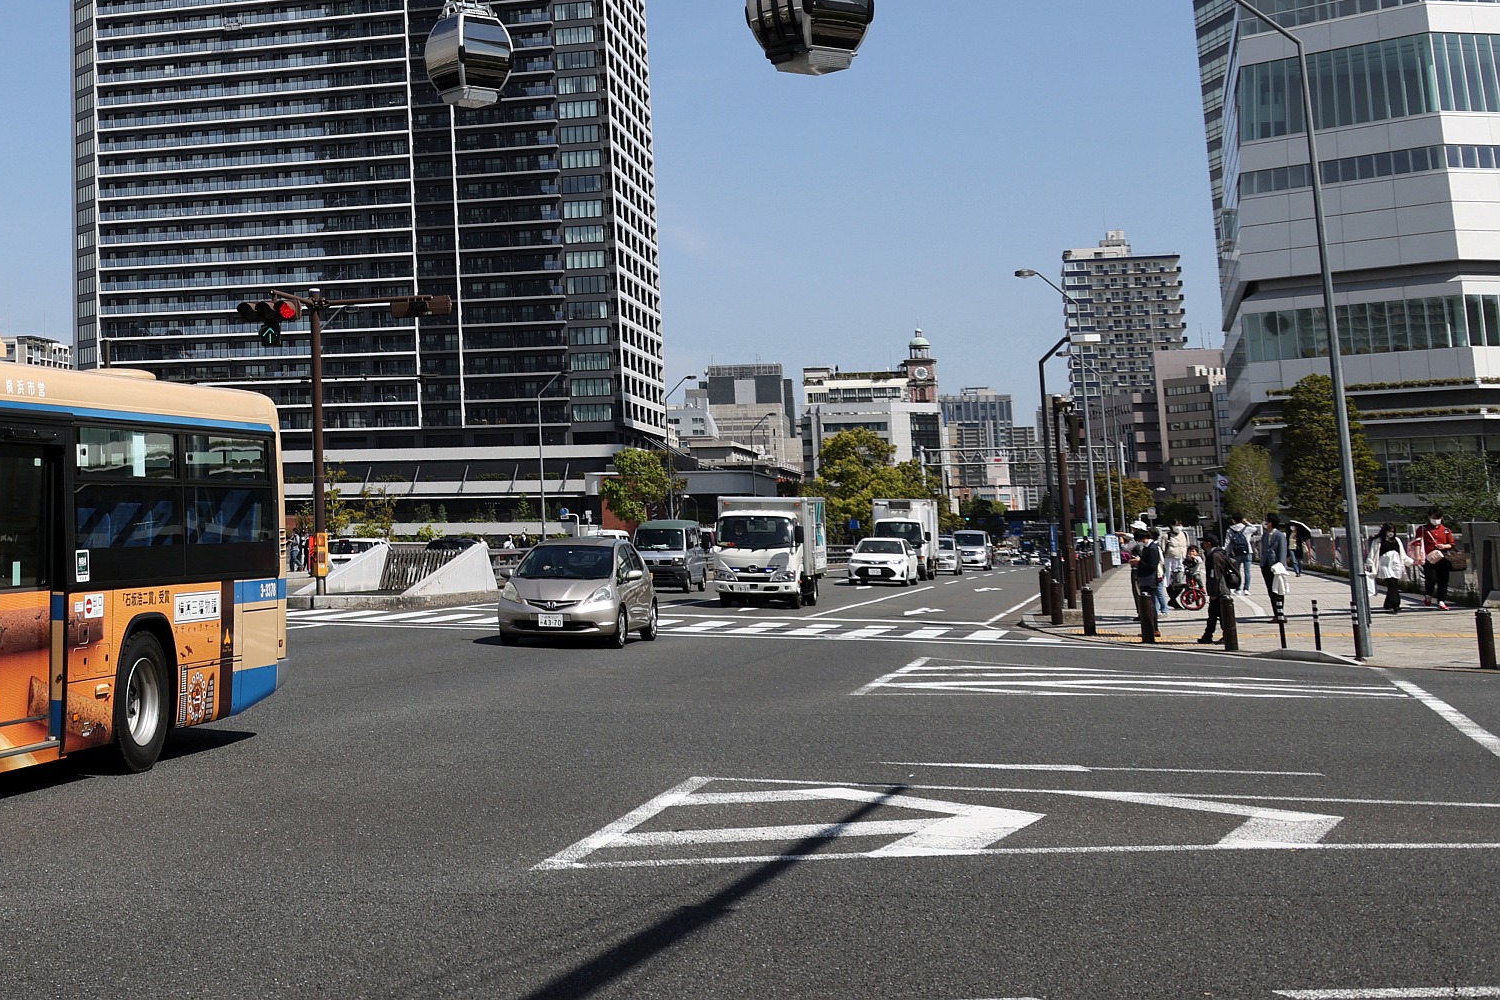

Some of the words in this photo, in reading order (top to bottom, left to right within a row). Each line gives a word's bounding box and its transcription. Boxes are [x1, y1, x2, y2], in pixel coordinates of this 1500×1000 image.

[5, 378, 46, 397] 横浜市営
[260, 583, 277, 598] 3-3378
